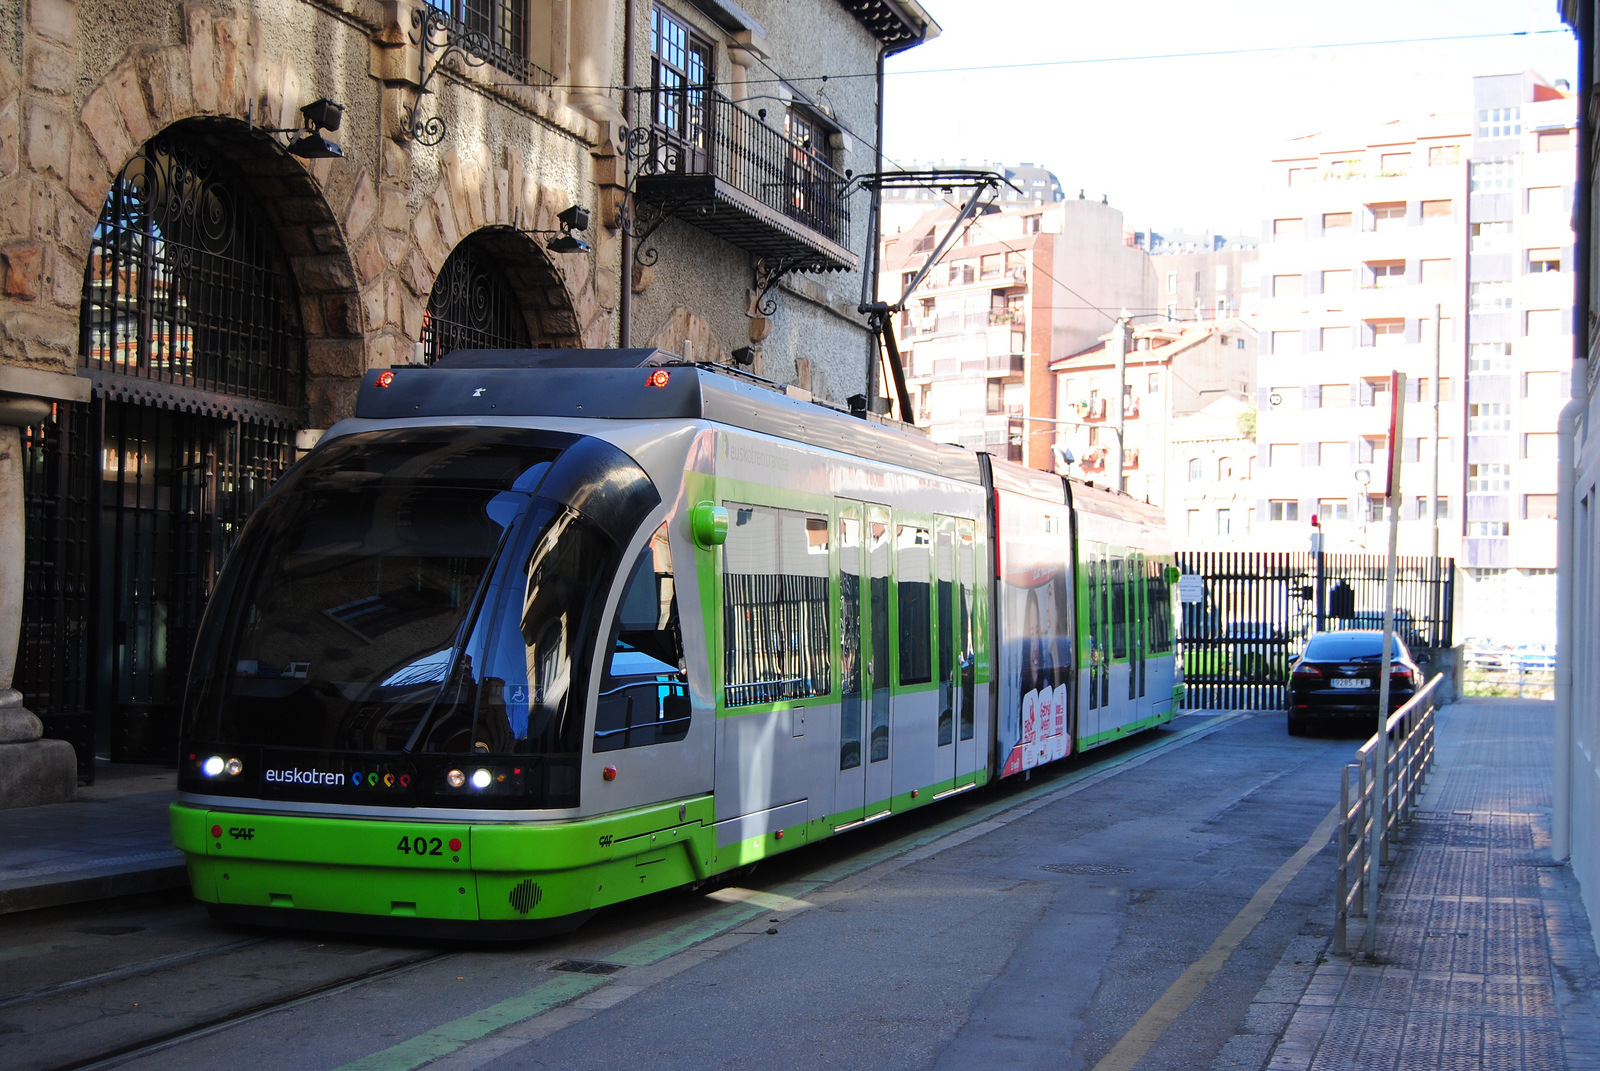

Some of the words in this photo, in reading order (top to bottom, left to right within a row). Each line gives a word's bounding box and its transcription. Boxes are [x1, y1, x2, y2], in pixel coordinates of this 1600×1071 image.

[266, 768, 344, 785] euskotren
[229, 827, 255, 840] CAF
[599, 834, 613, 847] CAF
[397, 836, 442, 855] 402
